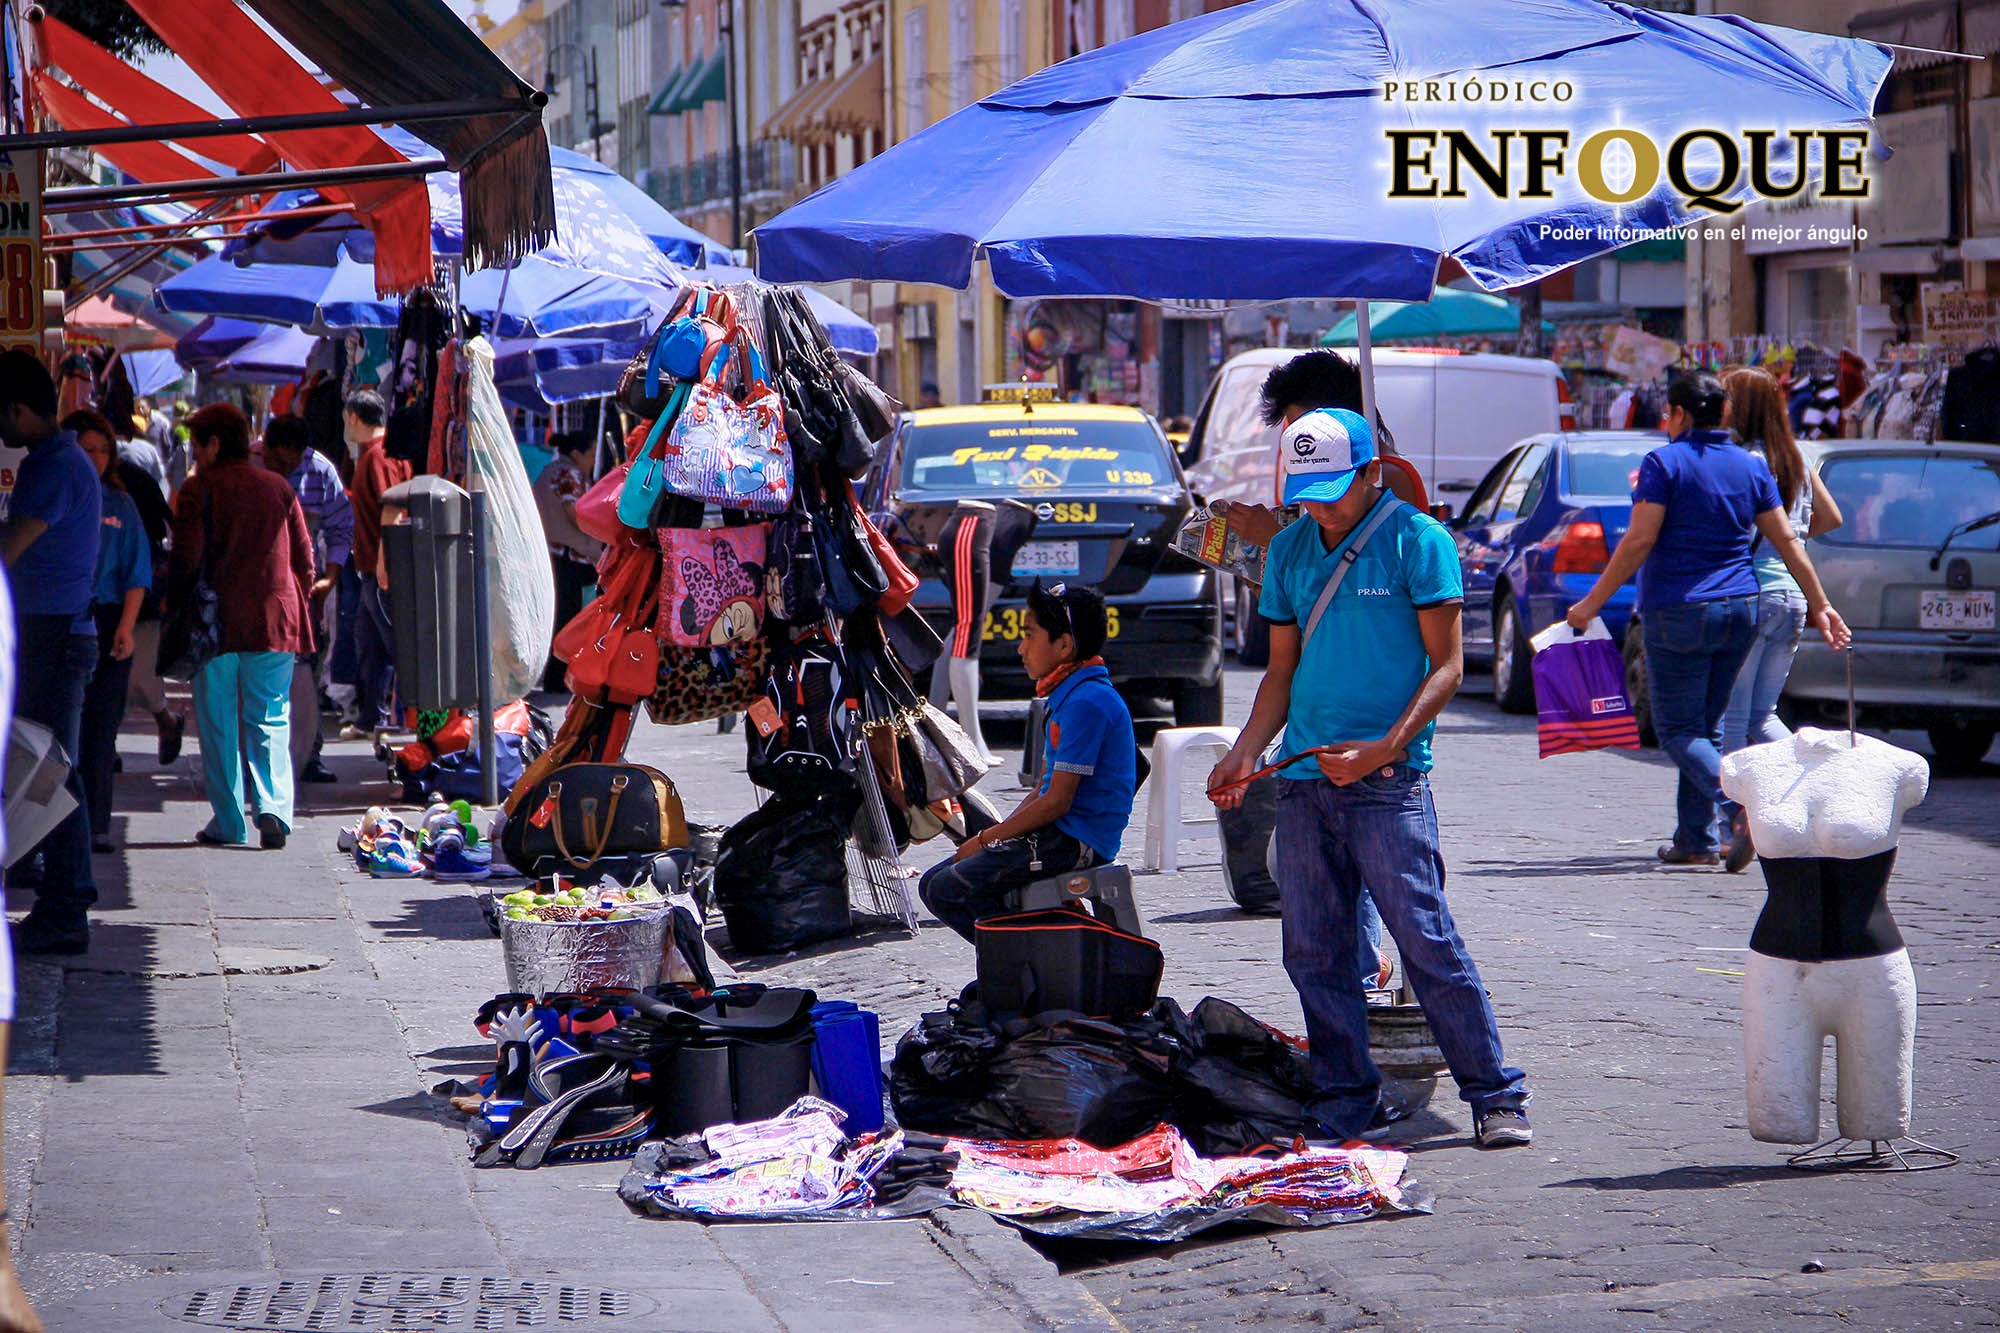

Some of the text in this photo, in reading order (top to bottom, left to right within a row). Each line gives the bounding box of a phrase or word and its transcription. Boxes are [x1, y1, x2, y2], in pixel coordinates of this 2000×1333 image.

[1020, 427, 1079, 437] MERCANTIL
[952, 447, 1017, 466] Taxi
[1054, 502, 1097, 523] SSJ
[1357, 588, 1391, 596] PRADA
